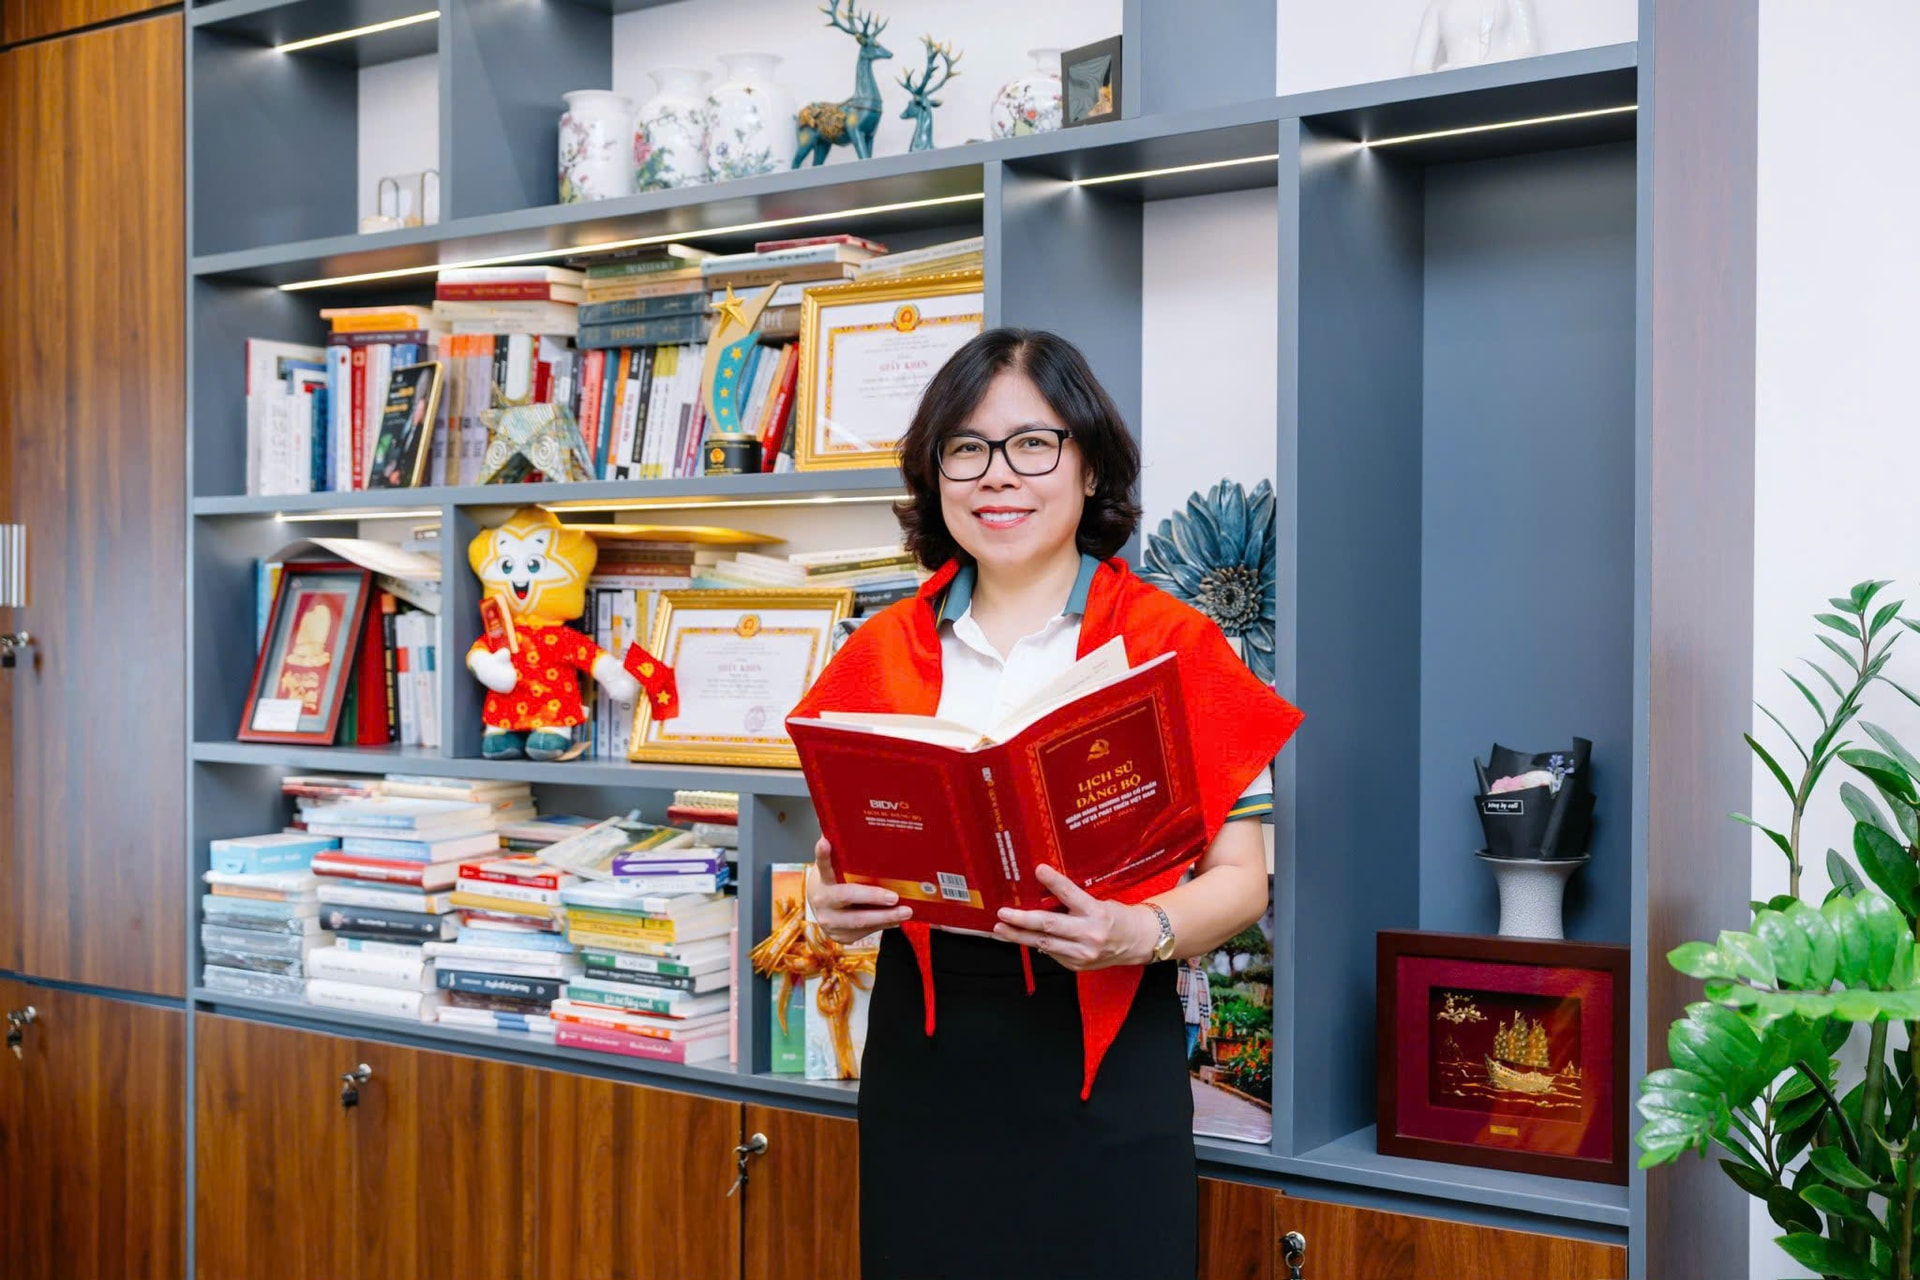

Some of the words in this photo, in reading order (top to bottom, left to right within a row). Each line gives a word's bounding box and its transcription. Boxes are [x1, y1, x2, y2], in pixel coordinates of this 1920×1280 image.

[1078, 771, 1112, 793] LỊCH
[1115, 760, 1134, 777] SỬ
[1120, 774, 1141, 790] BỘ
[869, 799, 898, 811] BIDV
